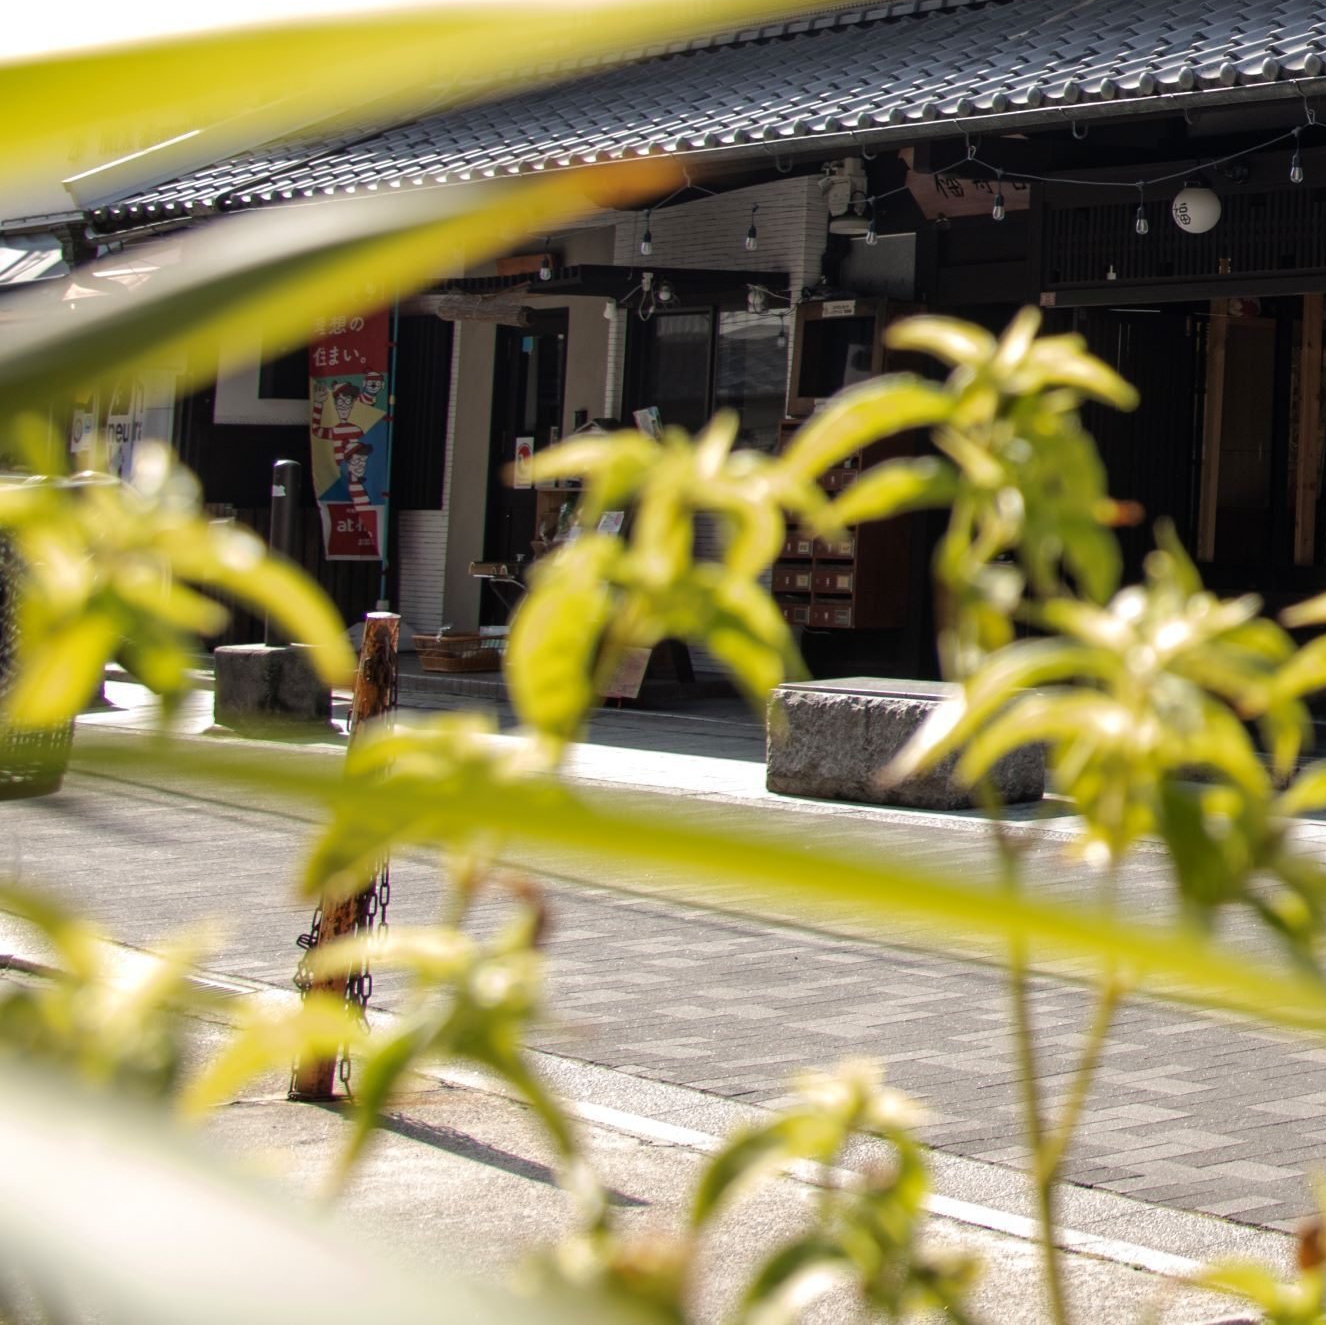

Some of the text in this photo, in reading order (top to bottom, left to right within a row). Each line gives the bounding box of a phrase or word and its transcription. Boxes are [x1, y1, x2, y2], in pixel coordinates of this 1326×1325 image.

[1172, 202, 1191, 225] 福
[313, 345, 367, 367] 住まい。
